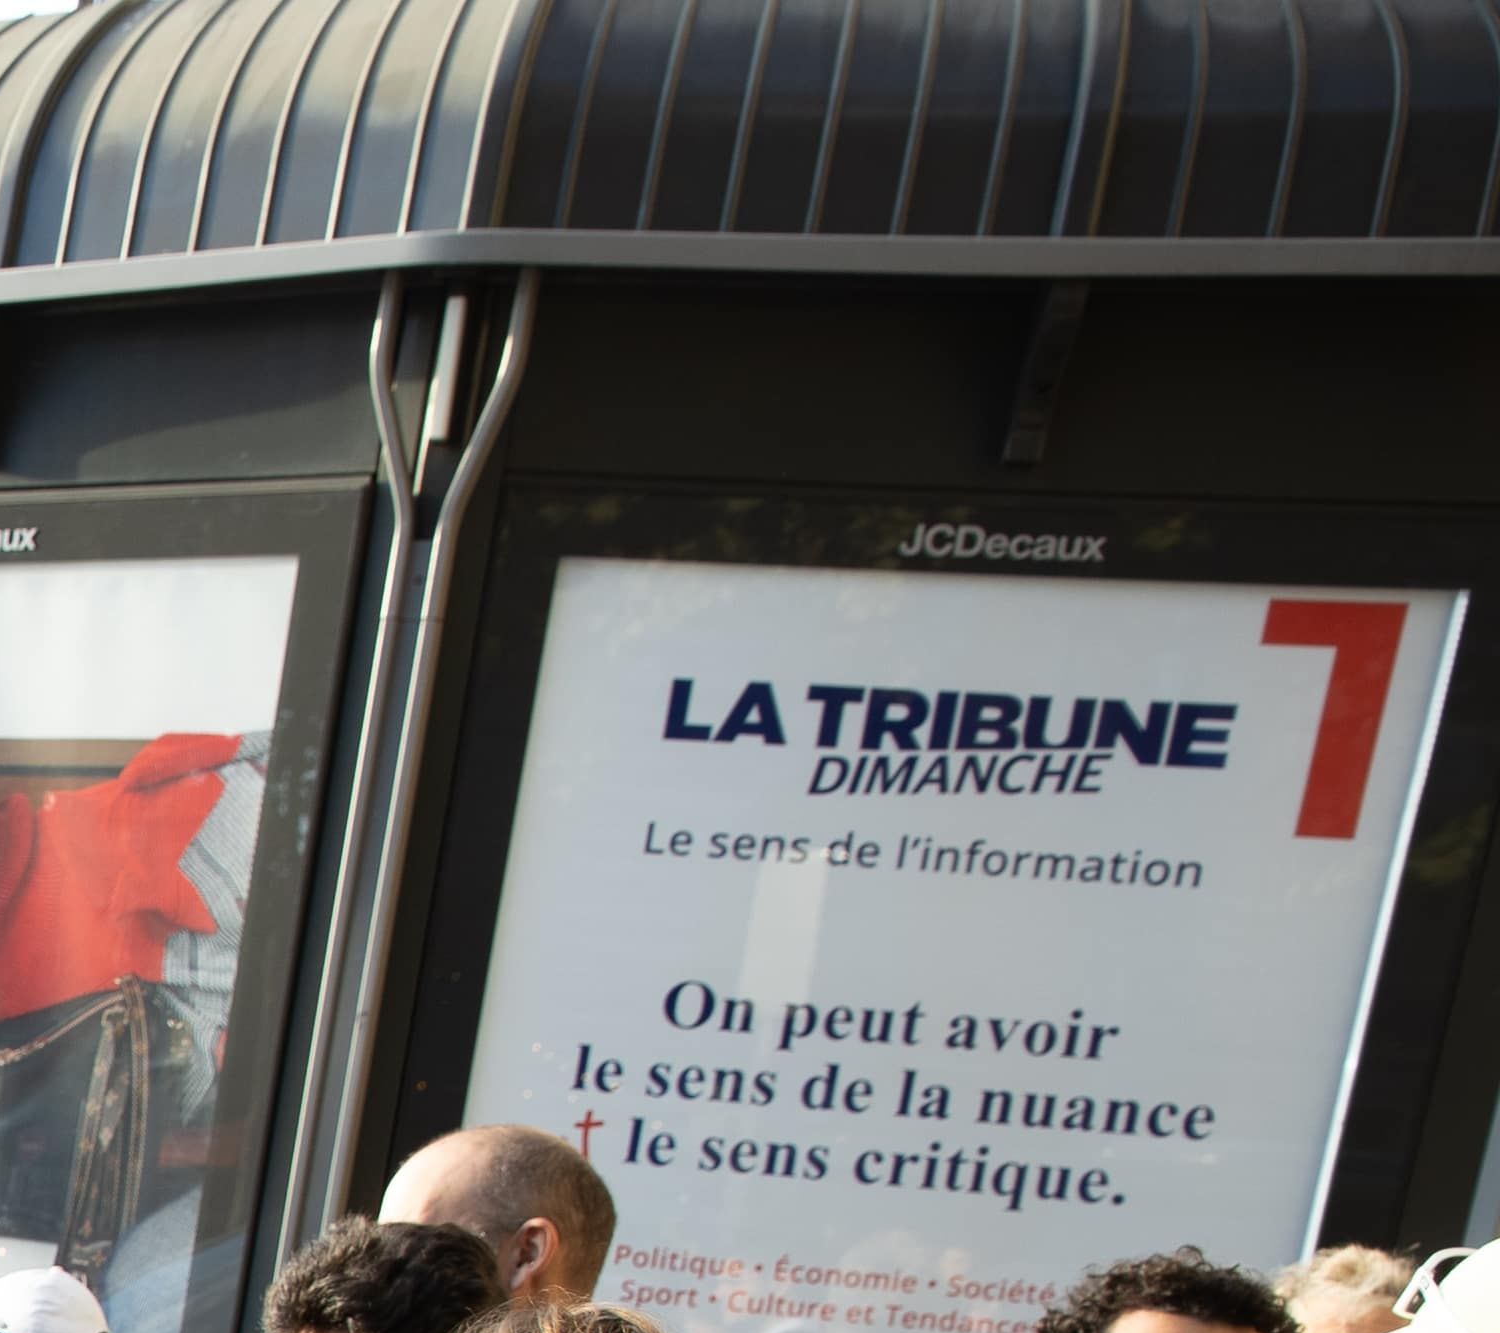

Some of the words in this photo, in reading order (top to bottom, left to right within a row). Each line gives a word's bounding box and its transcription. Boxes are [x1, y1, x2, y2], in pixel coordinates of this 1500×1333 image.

[900, 523, 1106, 562] JCDecaux
[662, 679, 786, 745] LA
[807, 685, 1238, 769] TRIBUNE
[808, 754, 1111, 795] DIMANCHE
[644, 821, 691, 856] Le
[708, 832, 810, 864] sens
[827, 831, 880, 867] de
[897, 834, 1204, 889] l'information
[662, 980, 754, 1033] On
[777, 1001, 923, 1051] peut
[945, 1009, 1120, 1060] avoir
[571, 1044, 623, 1093] le
[644, 1060, 778, 1106] sens
[802, 1063, 874, 1114] de
[895, 1069, 951, 1120] la
[975, 1088, 1216, 1140] nuance
[625, 1117, 676, 1166] le
[698, 1133, 829, 1182] sens
[853, 1142, 1126, 1213] critique.
[613, 1243, 744, 1279] Politique
[774, 1254, 918, 1296] Économie
[947, 1273, 1055, 1306] Société
[620, 1279, 697, 1308] Sport
[727, 1289, 836, 1321] Culture
[846, 1298, 874, 1326] et
